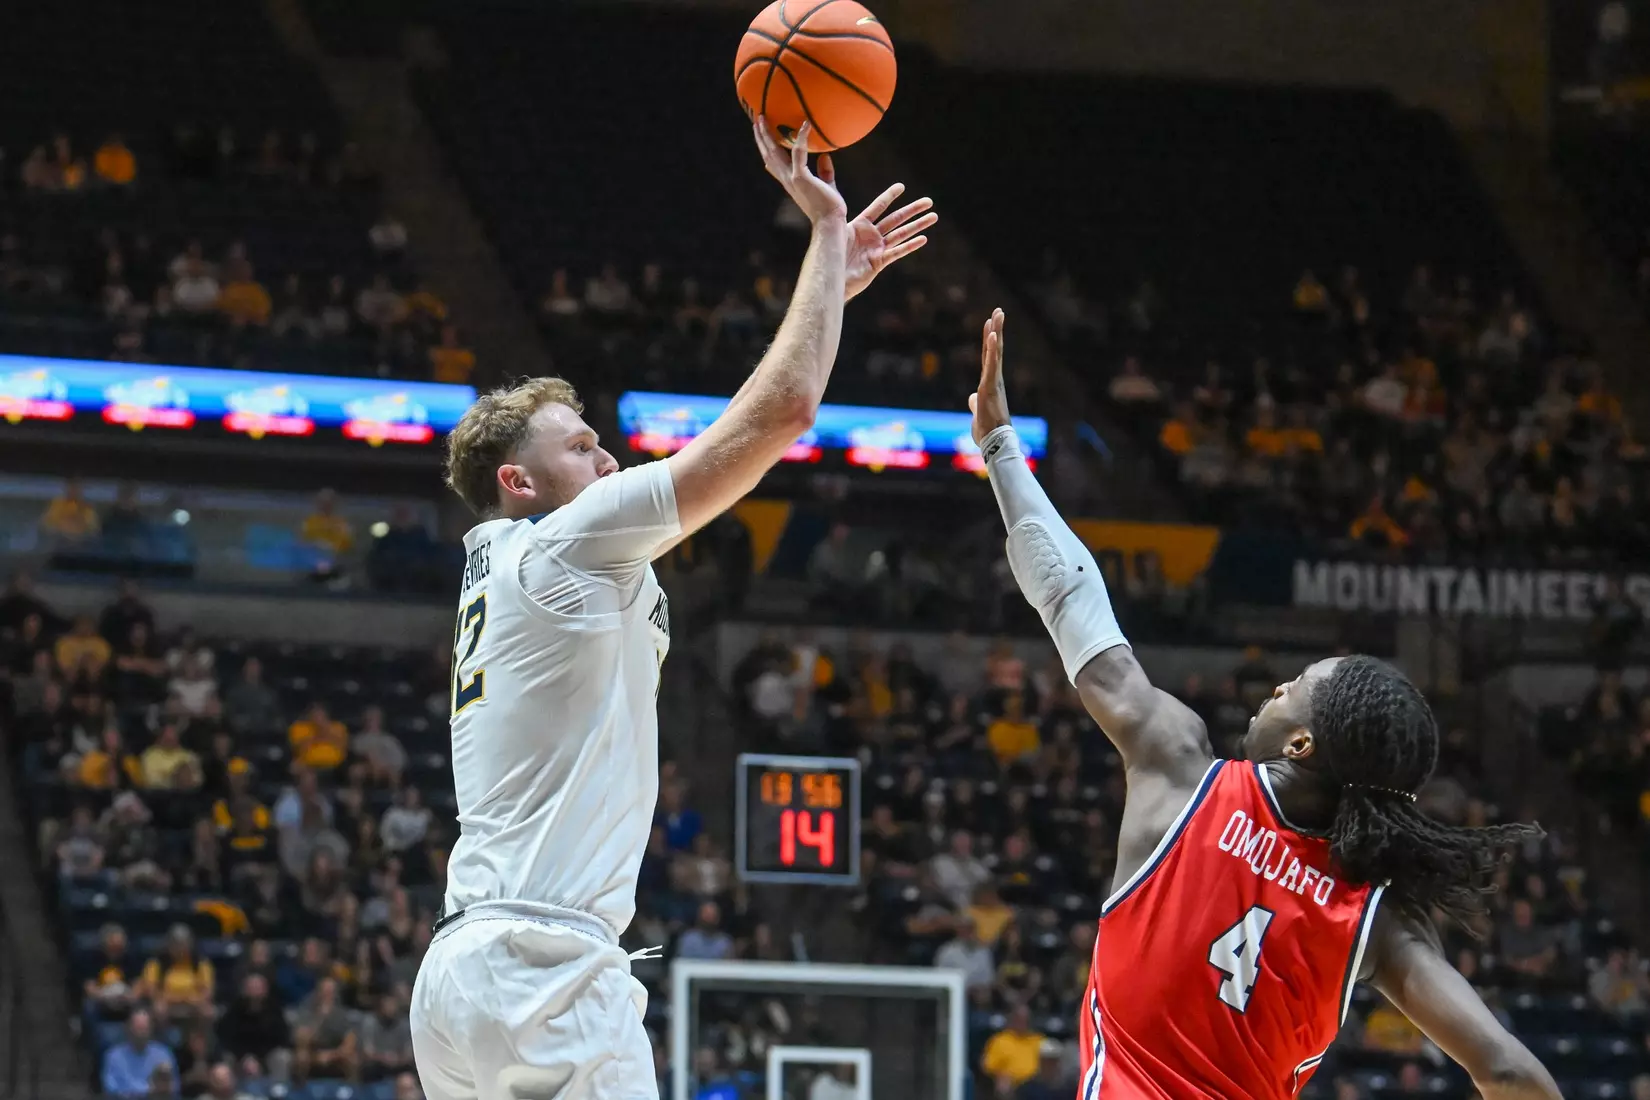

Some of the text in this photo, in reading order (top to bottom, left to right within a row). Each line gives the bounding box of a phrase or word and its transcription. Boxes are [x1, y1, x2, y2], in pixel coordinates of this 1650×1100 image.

[462, 540, 492, 594] EVRIES
[779, 809, 836, 868] 14
[1218, 809, 1335, 906] OMOJAFO
[1206, 903, 1277, 1016] 4
